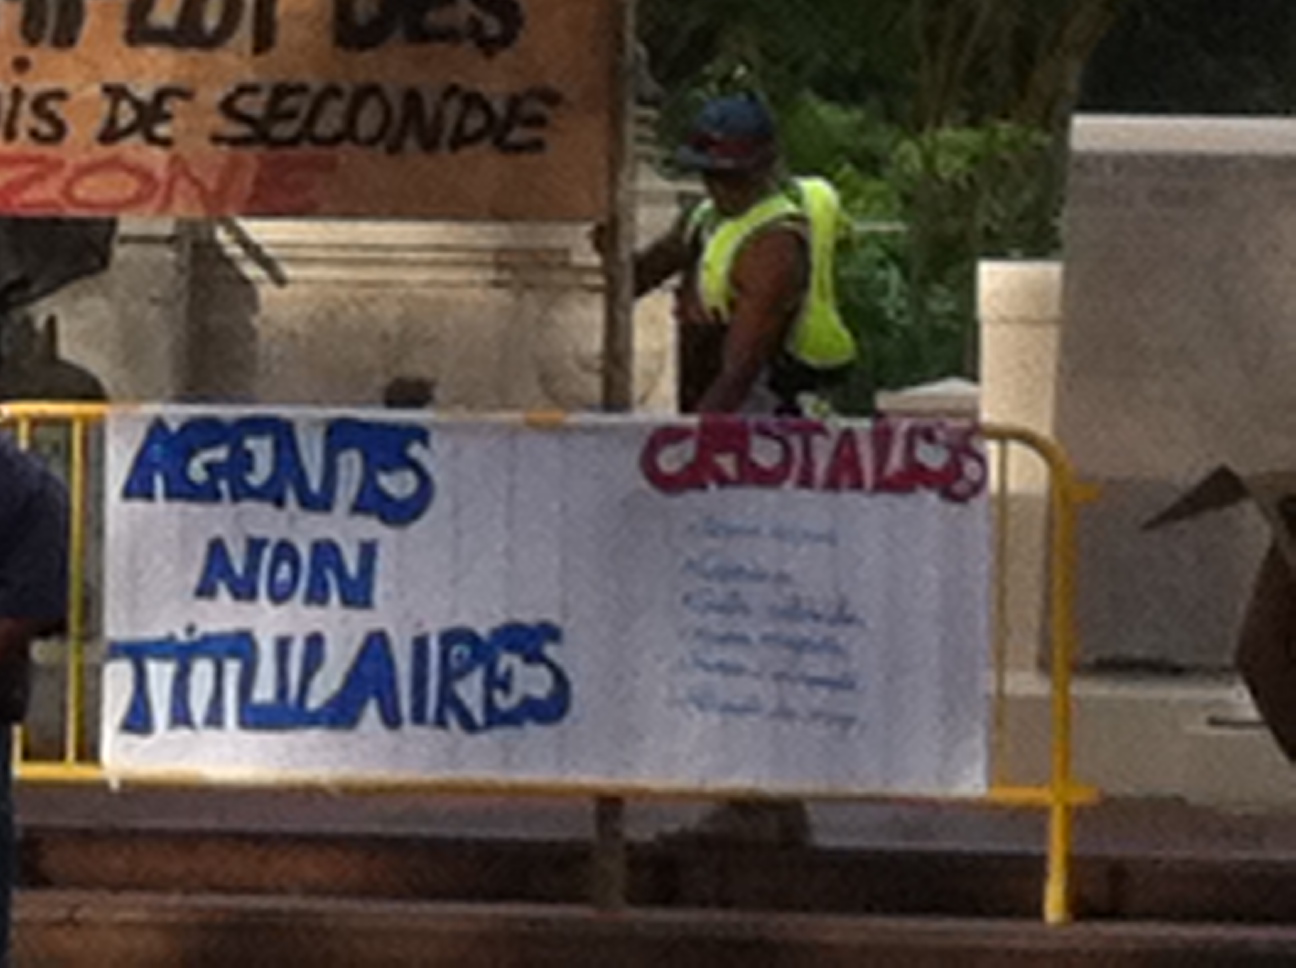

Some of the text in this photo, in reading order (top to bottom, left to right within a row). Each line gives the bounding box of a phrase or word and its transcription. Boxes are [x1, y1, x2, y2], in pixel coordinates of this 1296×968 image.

[96, 81, 193, 147] DE
[209, 83, 565, 156] SECONDE
[111, 417, 436, 529] AGENTS
[194, 536, 379, 610] NON
